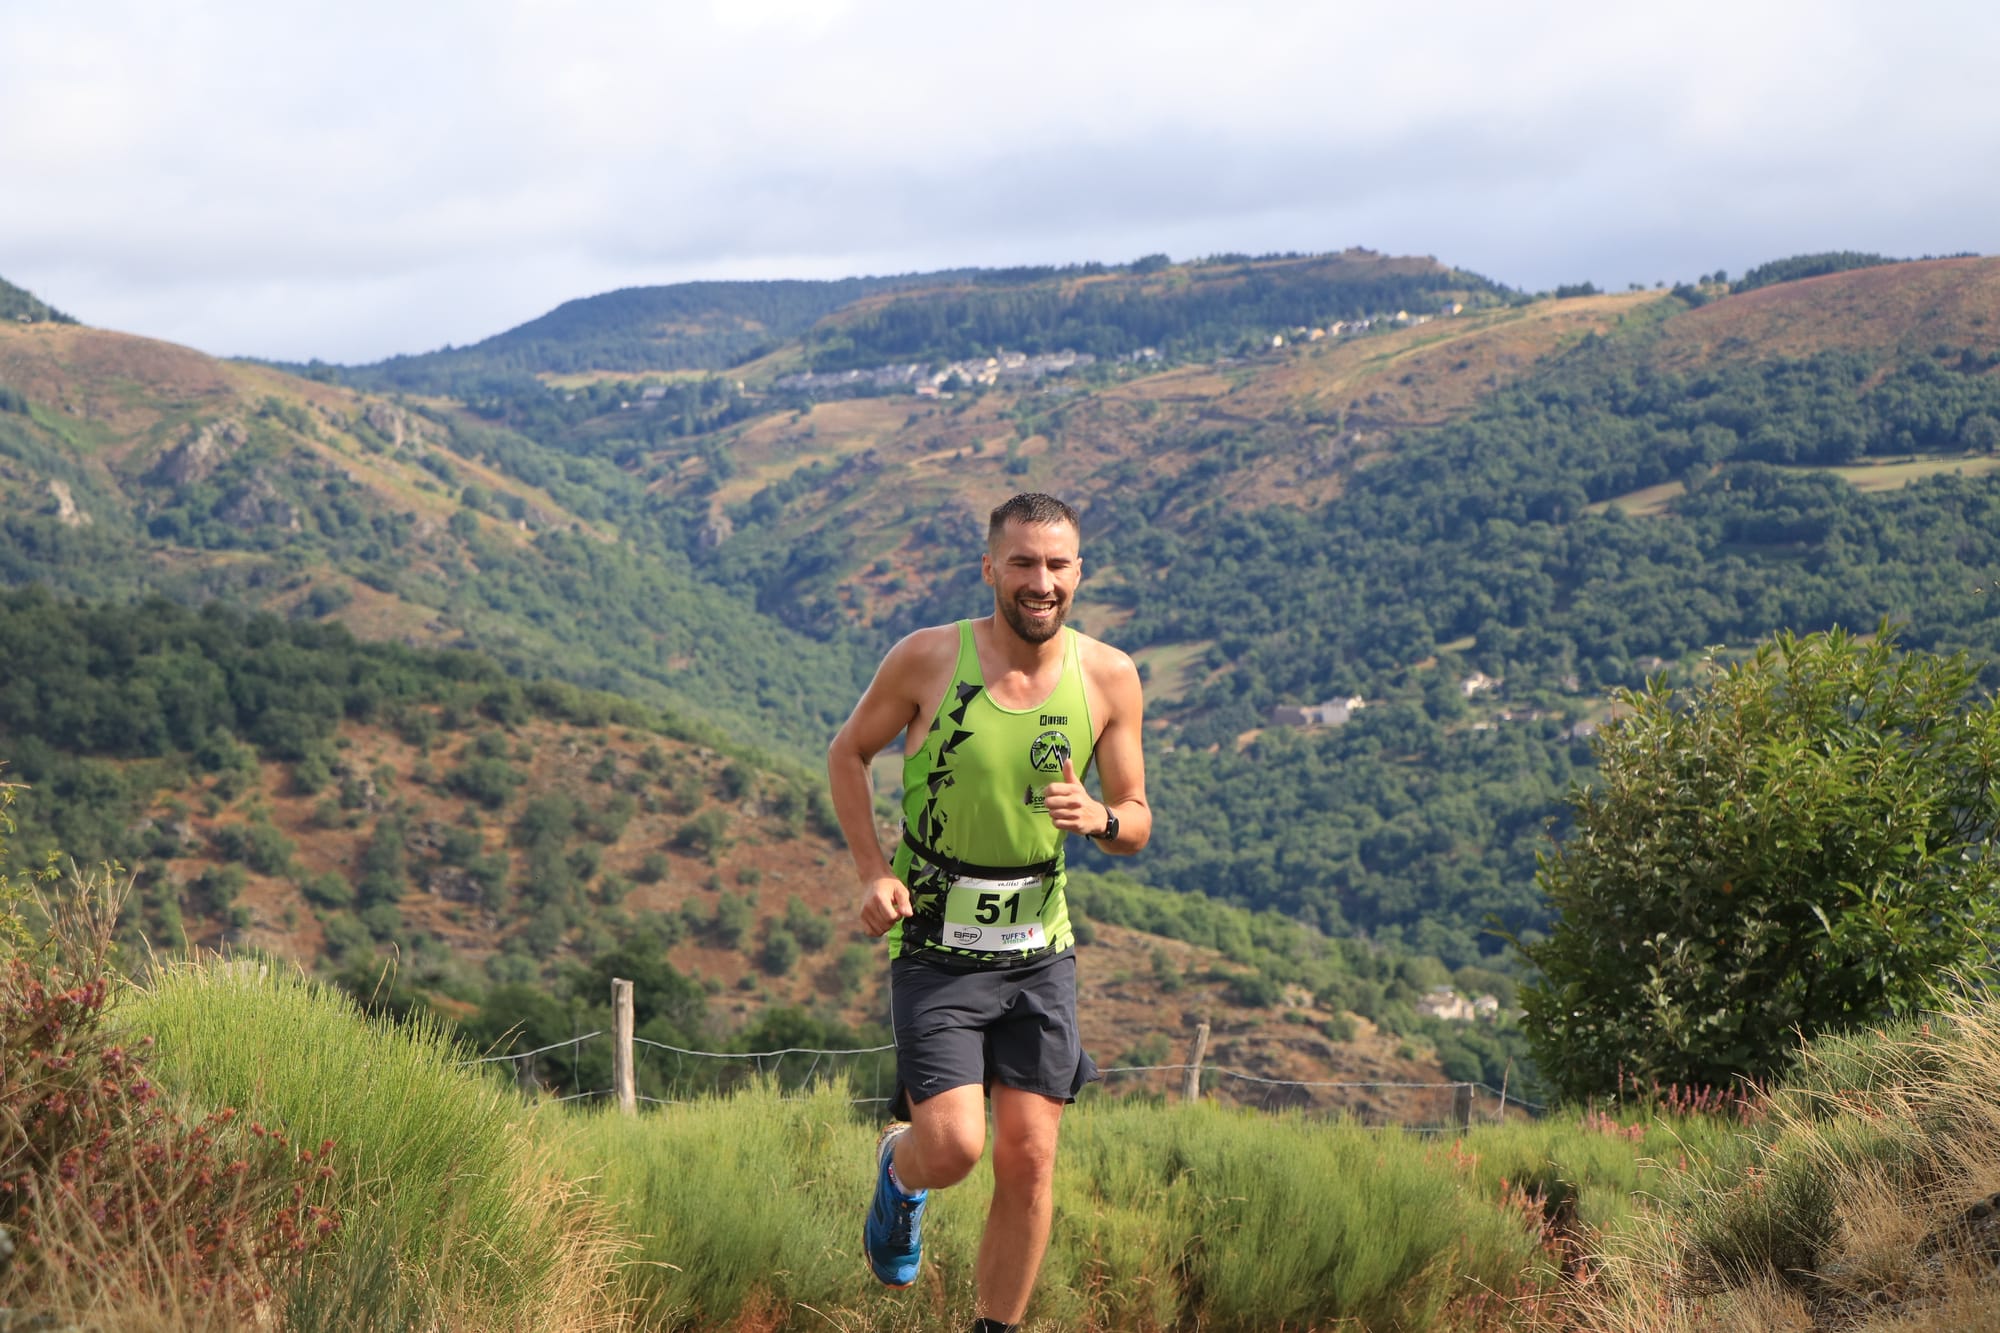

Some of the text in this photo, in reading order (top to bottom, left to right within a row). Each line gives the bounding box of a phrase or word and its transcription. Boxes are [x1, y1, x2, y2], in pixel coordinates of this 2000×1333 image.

[975, 893, 1020, 925] 51
[954, 931, 978, 939] BFP
[1001, 932, 1026, 941] TUFF'S
